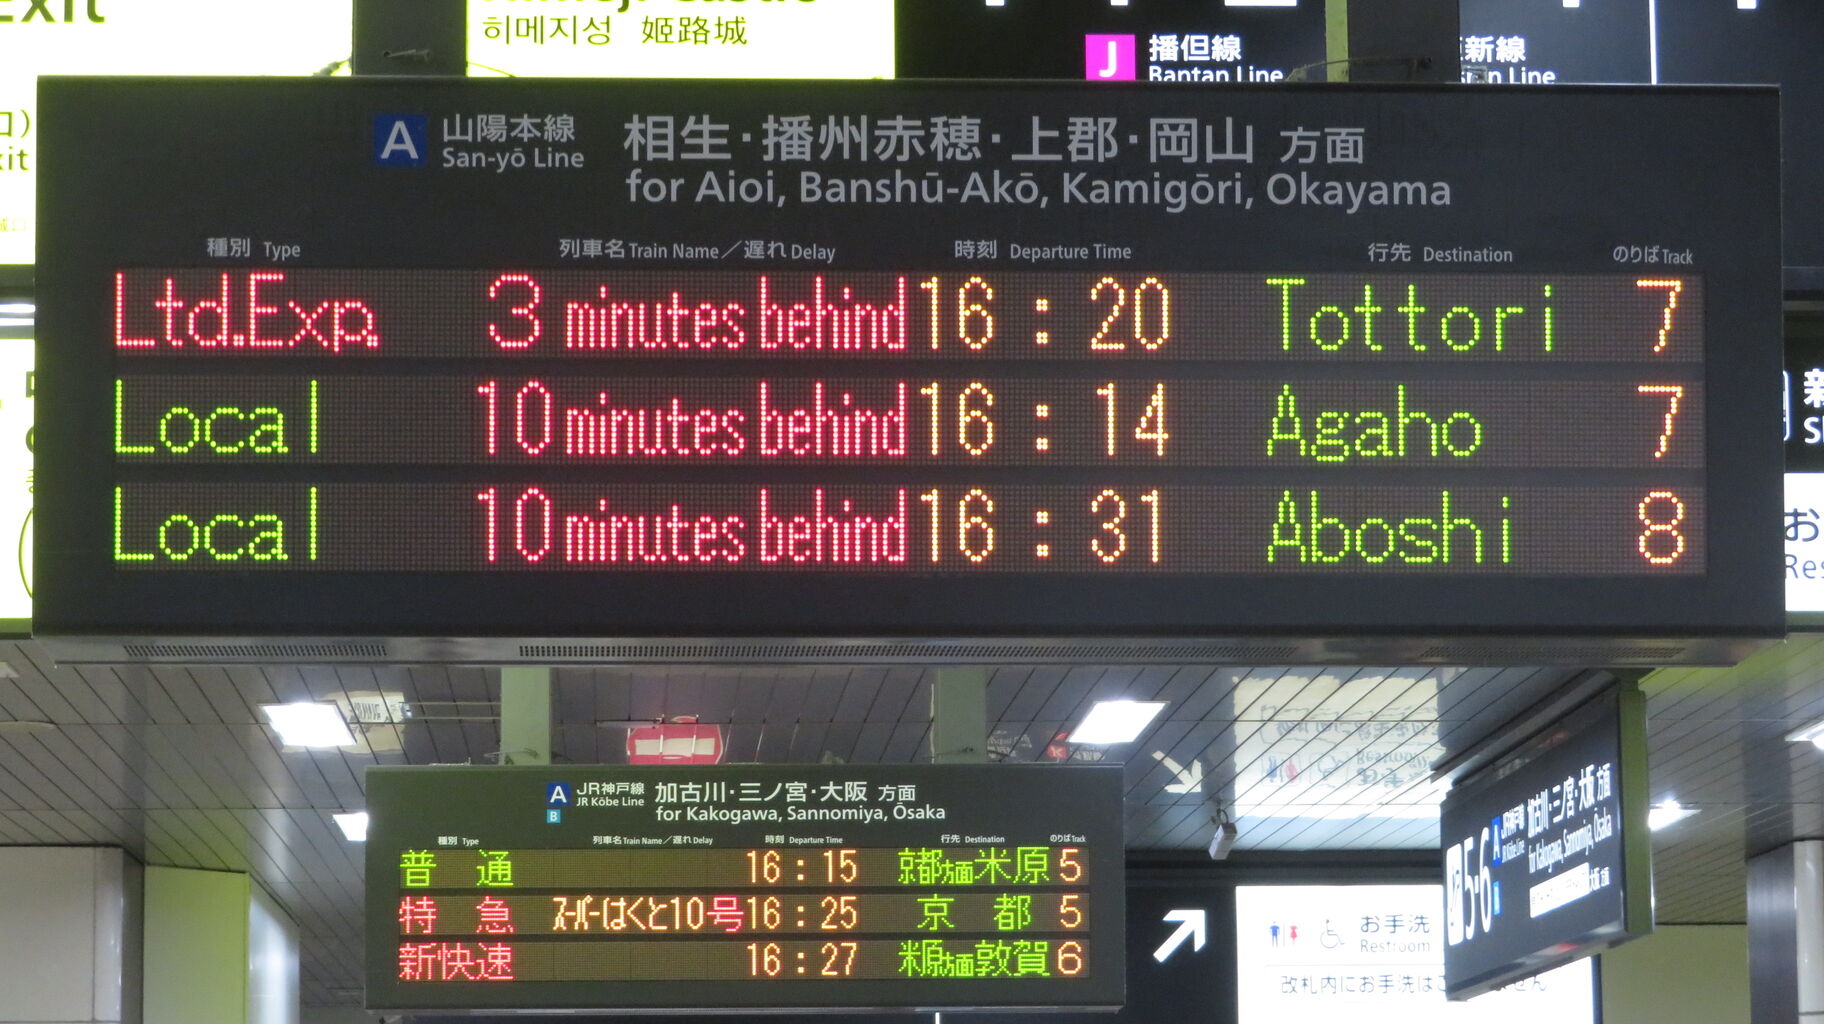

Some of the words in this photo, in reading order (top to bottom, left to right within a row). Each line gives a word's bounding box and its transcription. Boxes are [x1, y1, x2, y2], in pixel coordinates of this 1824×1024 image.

[483, 16, 610, 45] 히메지성
[1099, 41, 1117, 77] J
[1149, 35, 1241, 61] 播但線
[1460, 36, 1526, 62] 新線
[1149, 65, 1229, 81] Bantan
[1237, 65, 1283, 81] Line
[1509, 67, 1555, 84] Line
[381, 121, 418, 158] A
[444, 114, 574, 142] 山陽本線
[1280, 127, 1364, 163] 方面
[443, 148, 525, 172] San-yō
[535, 147, 584, 167] Line
[626, 169, 684, 202] for
[697, 170, 785, 207] Aioi,
[801, 170, 1048, 208] Banshū-Akō,
[1064, 172, 1253, 213] Kamigōri,
[1267, 172, 1450, 214] Okayama
[208, 238, 250, 257] 種別
[264, 242, 300, 261] Type
[560, 239, 624, 258] 列車名
[629, 243, 667, 258] Train
[792, 244, 835, 263] Delay
[955, 240, 997, 259] 時刻
[1011, 244, 1088, 262] Departure
[1094, 244, 1131, 258] Time
[1368, 243, 1410, 262] 行先
[1424, 247, 1512, 262] Destination
[1613, 246, 1659, 263] のりば
[1663, 249, 1692, 264] Track
[490, 274, 541, 349] 3
[567, 286, 746, 350] minutes
[760, 276, 907, 351] behind
[1267, 279, 1551, 351] Tottori
[1637, 280, 1681, 352] 7
[116, 380, 317, 453] Local
[478, 380, 553, 455] 10
[566, 392, 745, 456] minutes
[760, 382, 907, 456] behind
[1268, 384, 1481, 462] Agaho
[1638, 385, 1682, 458] 7
[1804, 417, 1824, 443] S
[115, 487, 316, 560] Local
[478, 488, 552, 562] 10
[566, 499, 746, 562] minutes
[760, 488, 906, 563] behind
[1268, 491, 1508, 563] Aboshi
[1639, 491, 1683, 564] 8
[1785, 554, 1824, 579] Re
[550, 786, 566, 802] A
[577, 783, 644, 795] JR神戸線
[879, 785, 916, 802] 方面
[577, 797, 589, 807] JR
[591, 795, 619, 807] Kōbe
[622, 797, 644, 807] Line
[550, 811, 557, 821] B
[656, 806, 681, 820] for
[687, 806, 782, 824] Kakogawa,
[788, 805, 887, 823] Sannomiya,
[893, 802, 946, 821] Ōsaka
[438, 836, 457, 845] 種別
[463, 838, 479, 846] Type
[593, 835, 622, 845] 列車名
[623, 836, 640, 845] Train
[693, 836, 713, 846] Delay
[765, 835, 784, 843] 時刻
[789, 836, 823, 845] Departure
[826, 836, 843, 844] Time
[941, 835, 960, 843] 行先
[1050, 834, 1071, 842] のりば
[1060, 848, 1081, 881] 5
[1060, 895, 1081, 928] 5
[1361, 915, 1429, 933] お手洗
[1361, 939, 1429, 952] Restroom
[399, 942, 514, 980] 新快速
[899, 940, 1050, 976] 米原方面敦賀
[1058, 941, 1081, 974] 6
